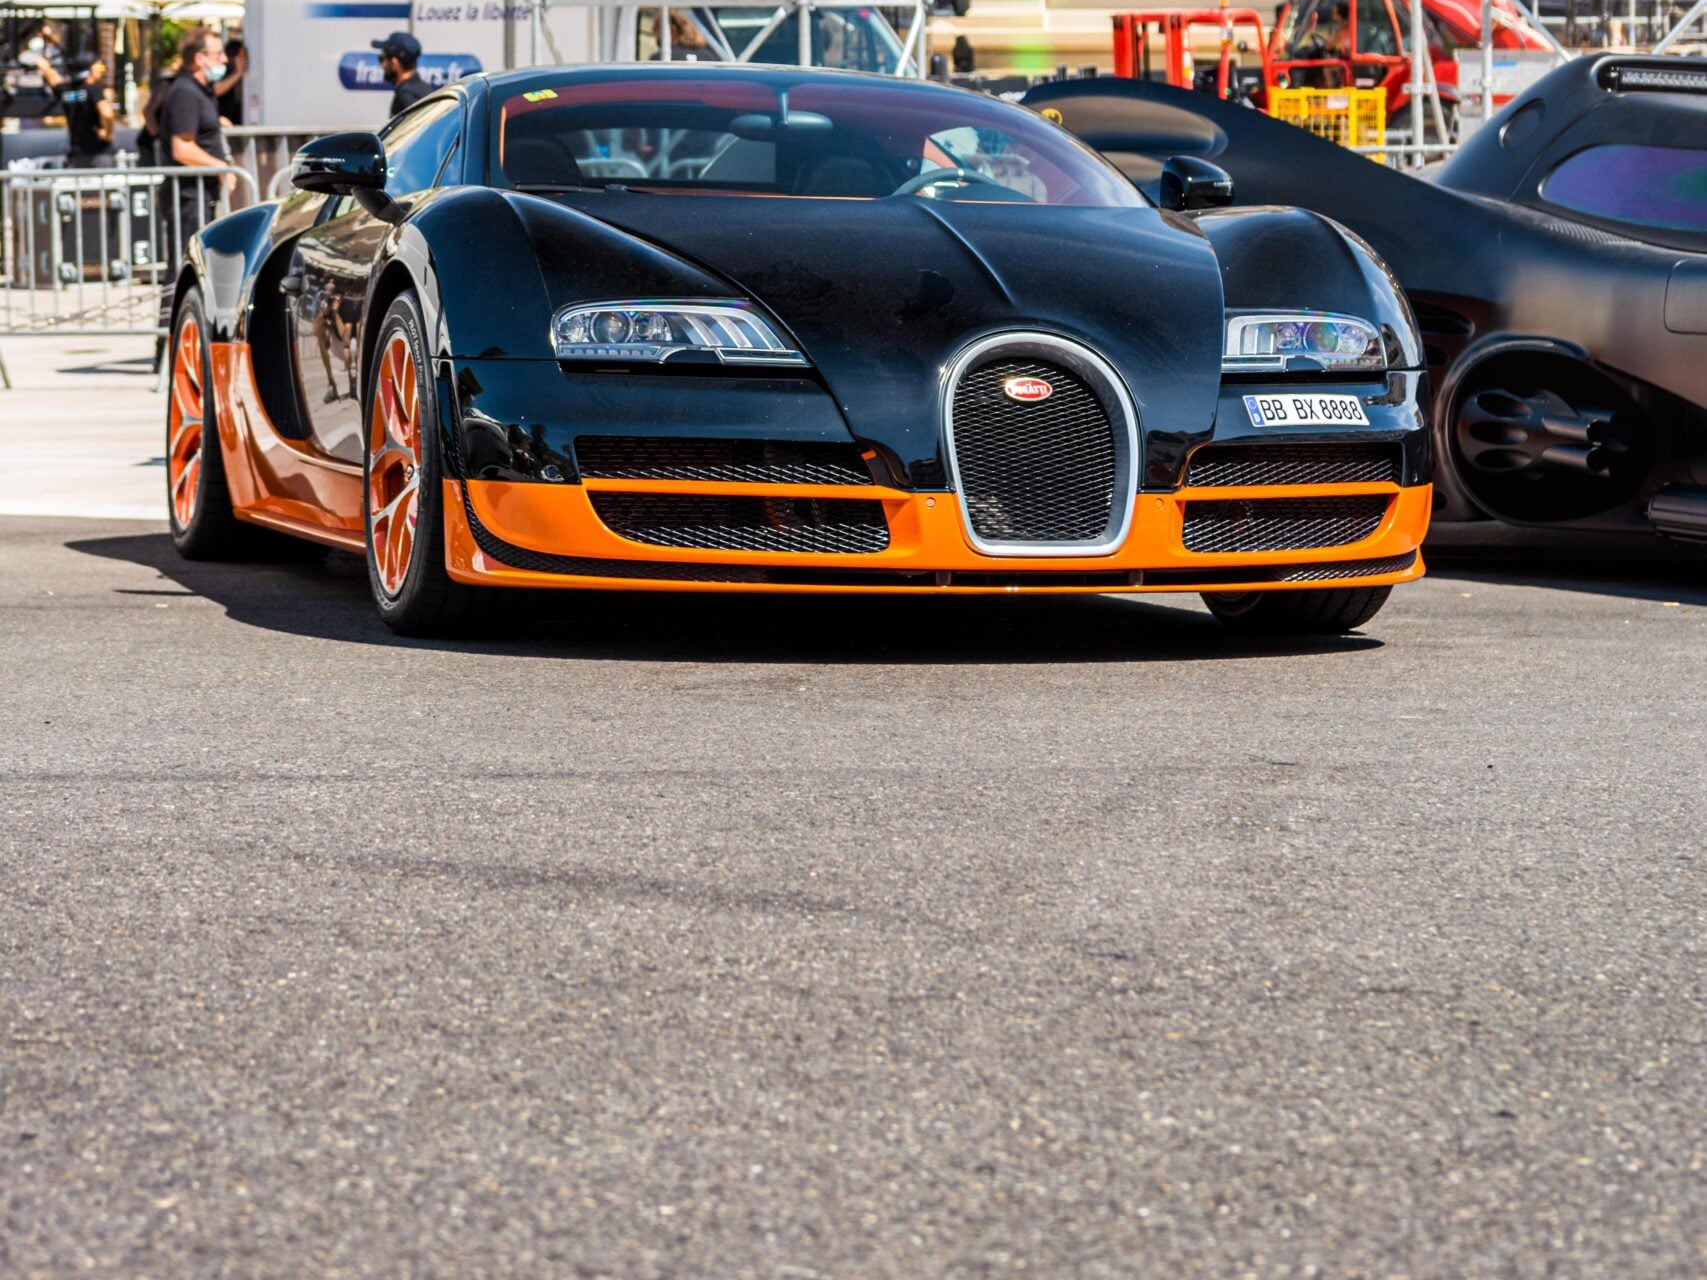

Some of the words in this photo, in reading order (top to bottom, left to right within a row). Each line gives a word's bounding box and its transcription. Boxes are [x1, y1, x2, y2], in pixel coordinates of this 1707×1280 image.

[417, 1, 461, 21] Louez
[465, 1, 479, 21] la
[1260, 399, 1287, 421] BB
[1293, 399, 1320, 420] BX
[1319, 399, 1363, 421] 8888
